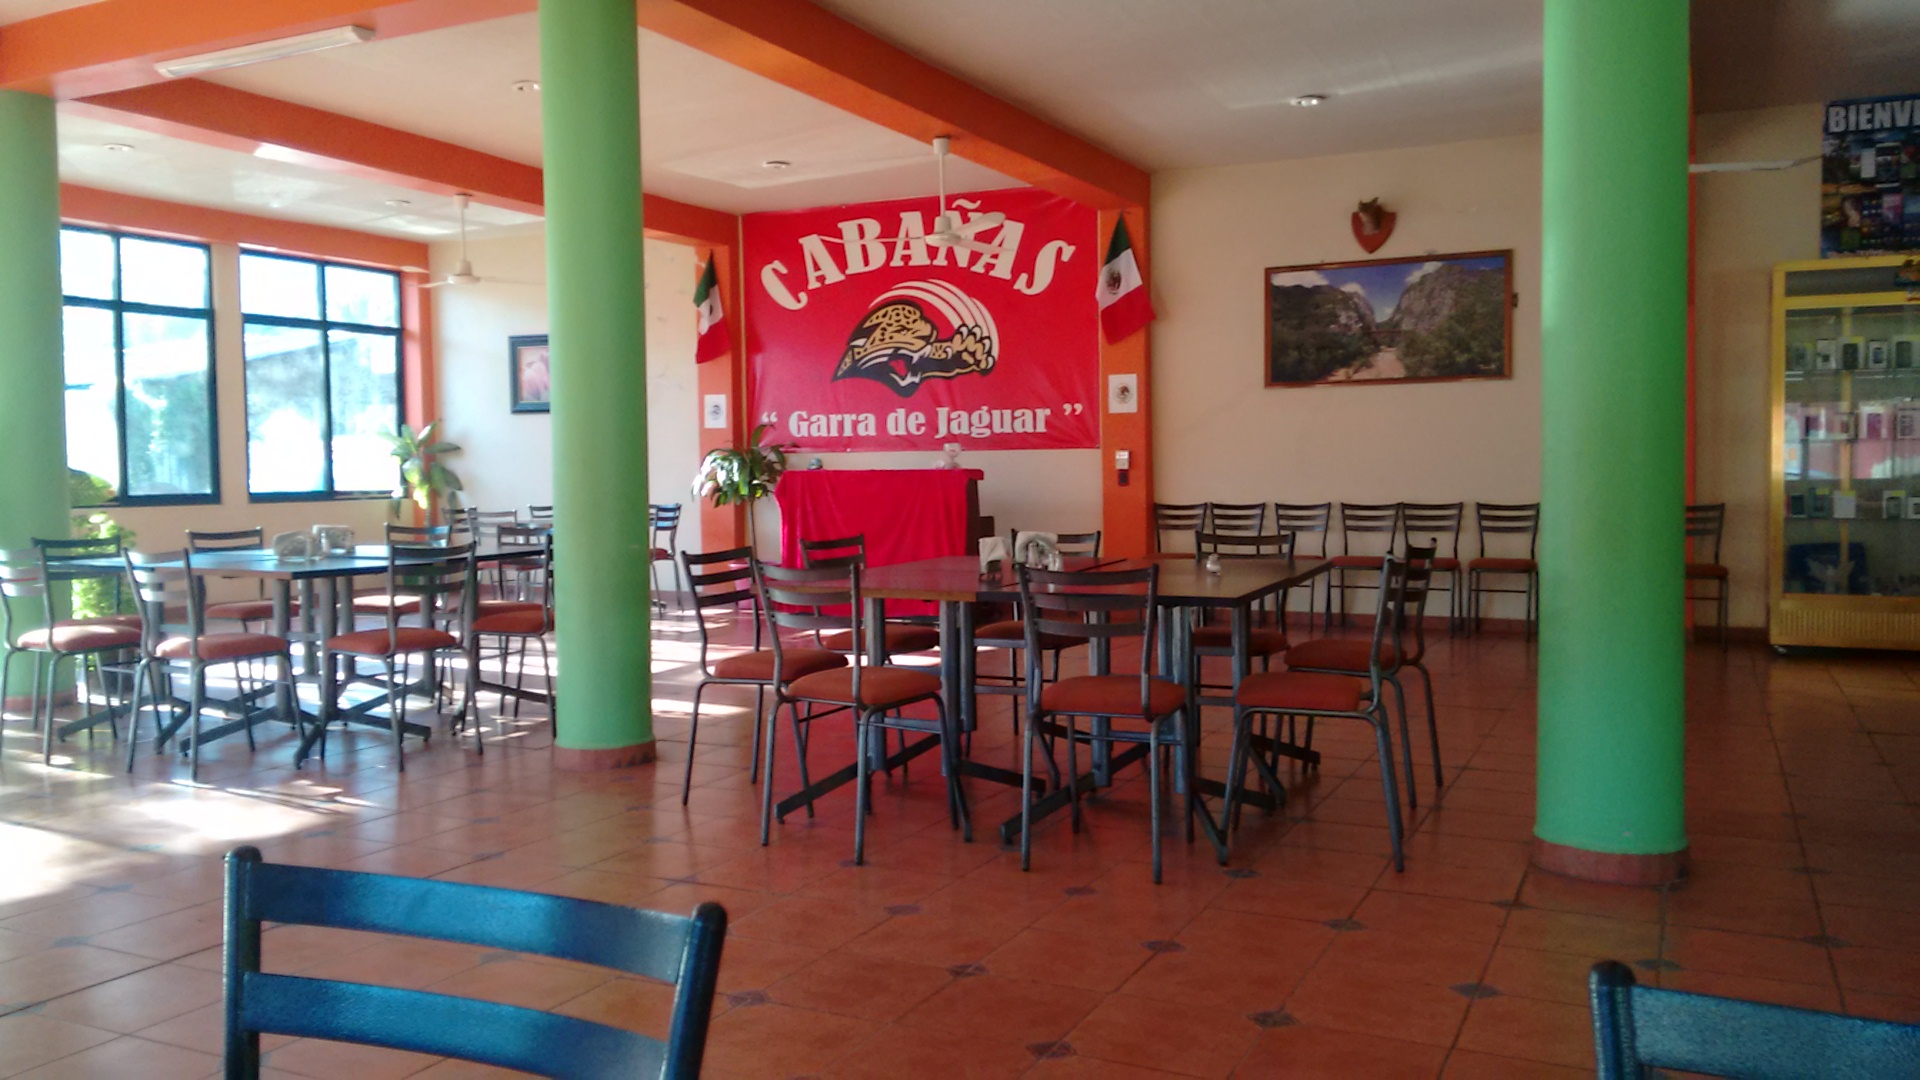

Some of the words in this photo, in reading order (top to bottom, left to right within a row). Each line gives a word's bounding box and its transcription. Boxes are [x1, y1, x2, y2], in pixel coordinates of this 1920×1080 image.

[760, 198, 1076, 310] CABAÑAS
[788, 410, 876, 438] Garra
[886, 408, 926, 437] de
[934, 405, 1051, 438] Jaguar
